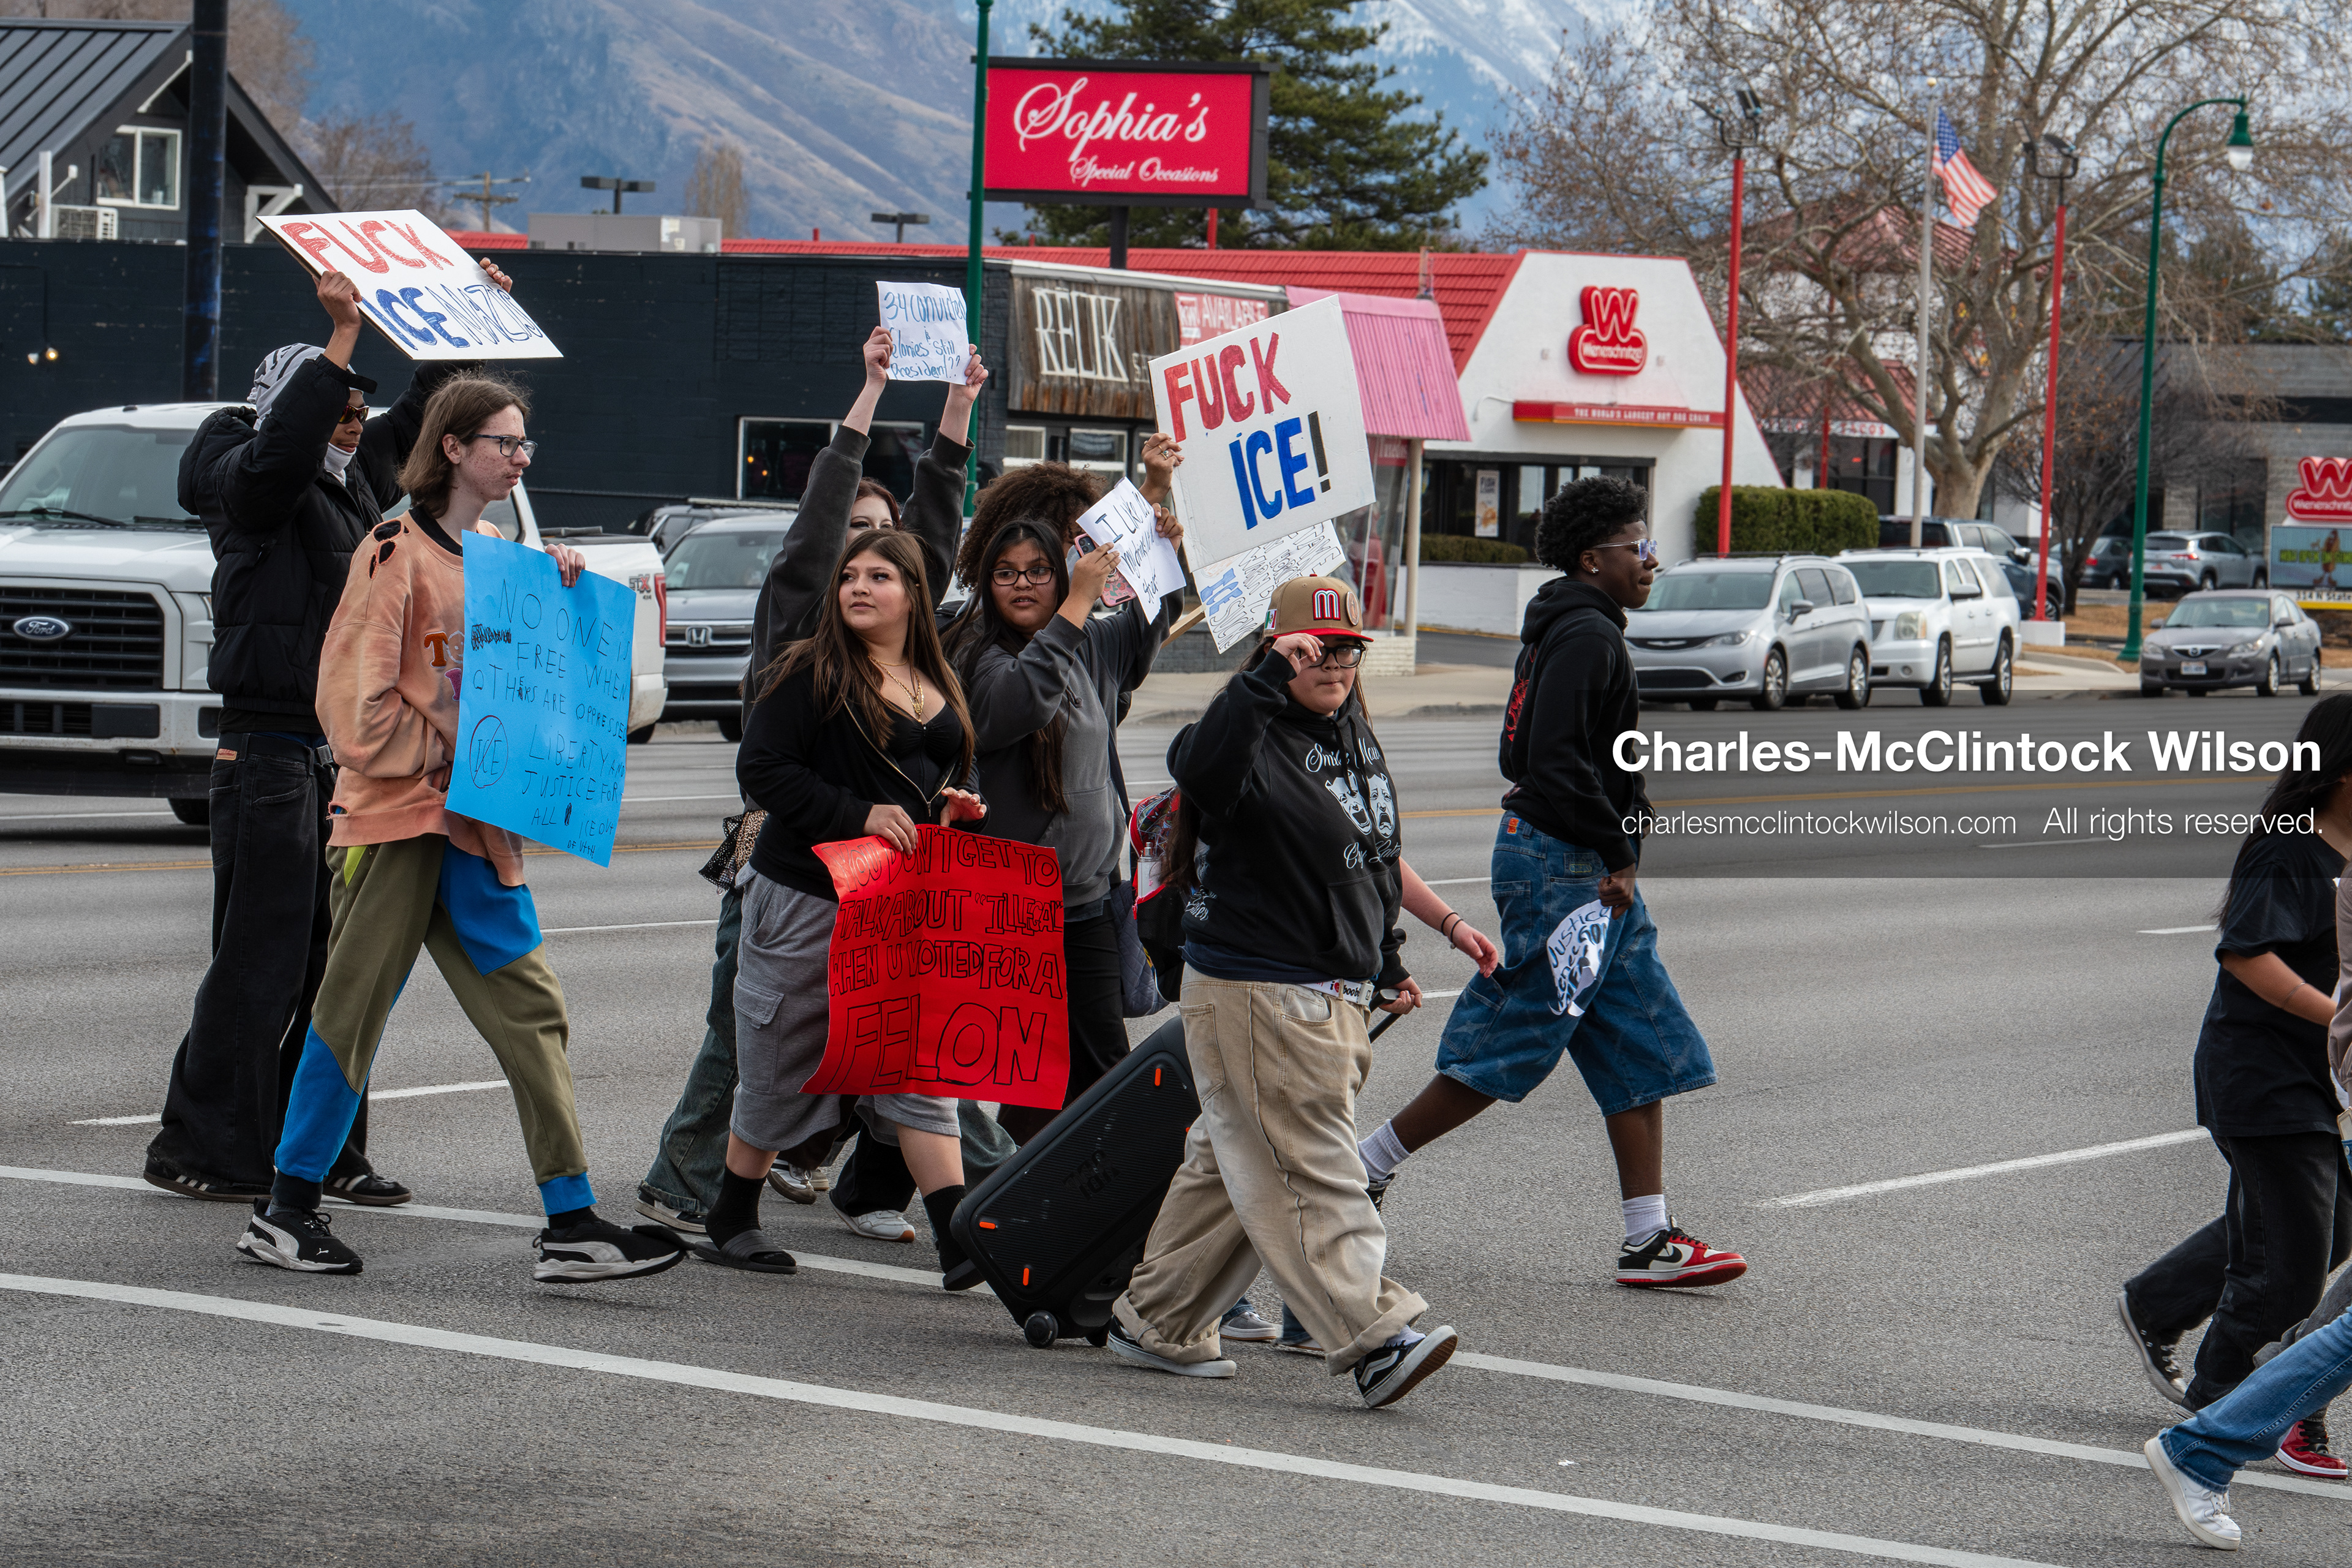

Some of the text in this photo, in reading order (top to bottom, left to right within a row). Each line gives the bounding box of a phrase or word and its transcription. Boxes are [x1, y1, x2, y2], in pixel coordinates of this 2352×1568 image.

[1013, 77, 1209, 162] Sophia's
[1069, 155, 1219, 187] Special Occasions
[281, 220, 454, 274] FUCK
[361, 287, 470, 351] ICE
[884, 292, 908, 322] 34
[1590, 290, 1640, 343] W
[1031, 286, 1129, 383] RELIK
[1164, 331, 1291, 443] FUCK
[1229, 410, 1331, 530] ICE!
[1095, 513, 1123, 543] I
[629, 574, 651, 594] STX
[1200, 568, 1258, 650] ICE SUCKS
[26, 620, 56, 635] Ford
[499, 578, 542, 630] NO
[556, 608, 613, 657] ONE
[517, 642, 628, 702] FREE WHEN
[543, 688, 567, 715] ARE
[522, 769, 597, 801] JUSTICE
[531, 806, 557, 826] ALL
[567, 840, 576, 850] OF
[821, 842, 882, 892] YOU
[957, 834, 1011, 869] GET
[1014, 846, 1060, 888] TO
[839, 895, 891, 941] TALK
[881, 889, 972, 941] ABOUT
[829, 939, 1063, 1000] WHEN U VOTED FOR A
[822, 993, 1047, 1093] FELON
